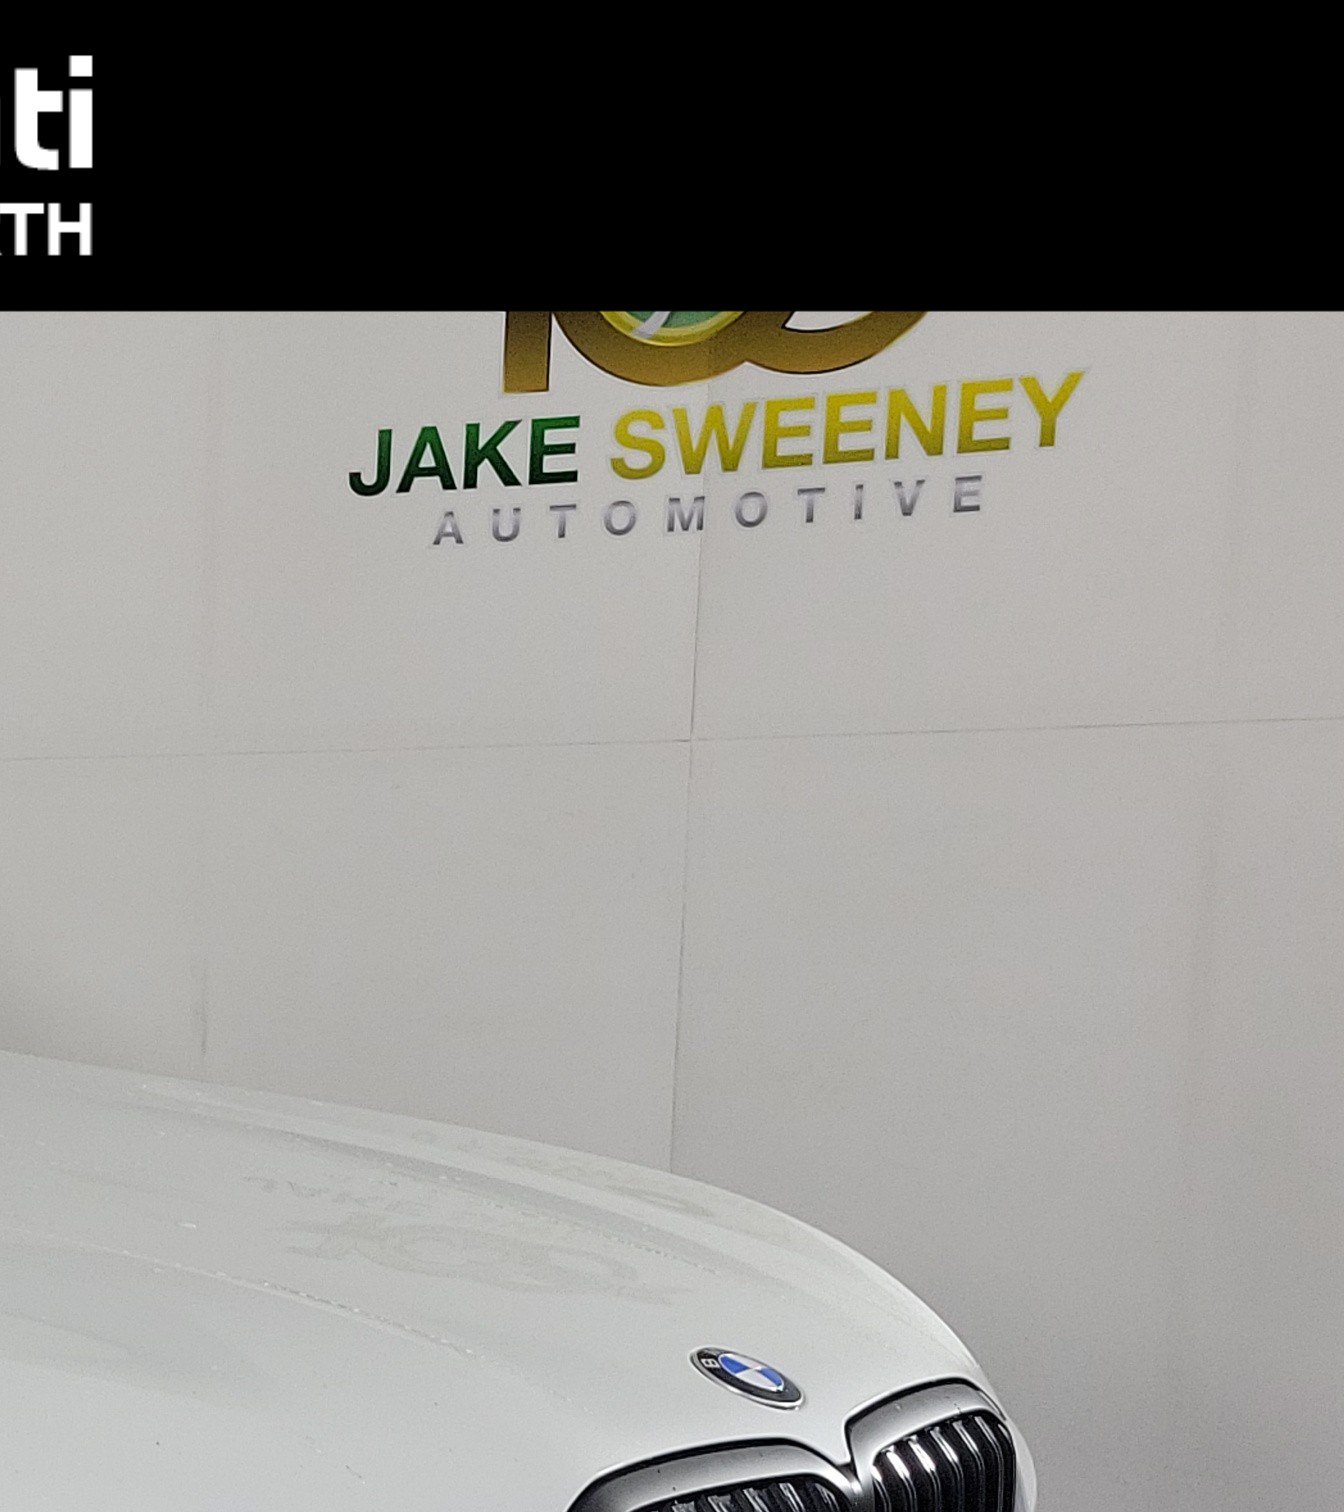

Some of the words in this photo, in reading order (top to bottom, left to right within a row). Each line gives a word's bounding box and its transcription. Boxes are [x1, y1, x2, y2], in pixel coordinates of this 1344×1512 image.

[348, 415, 581, 497] JAKE
[610, 371, 1084, 480] SWEENEY
[432, 475, 984, 546] AUTOMOTIVE
